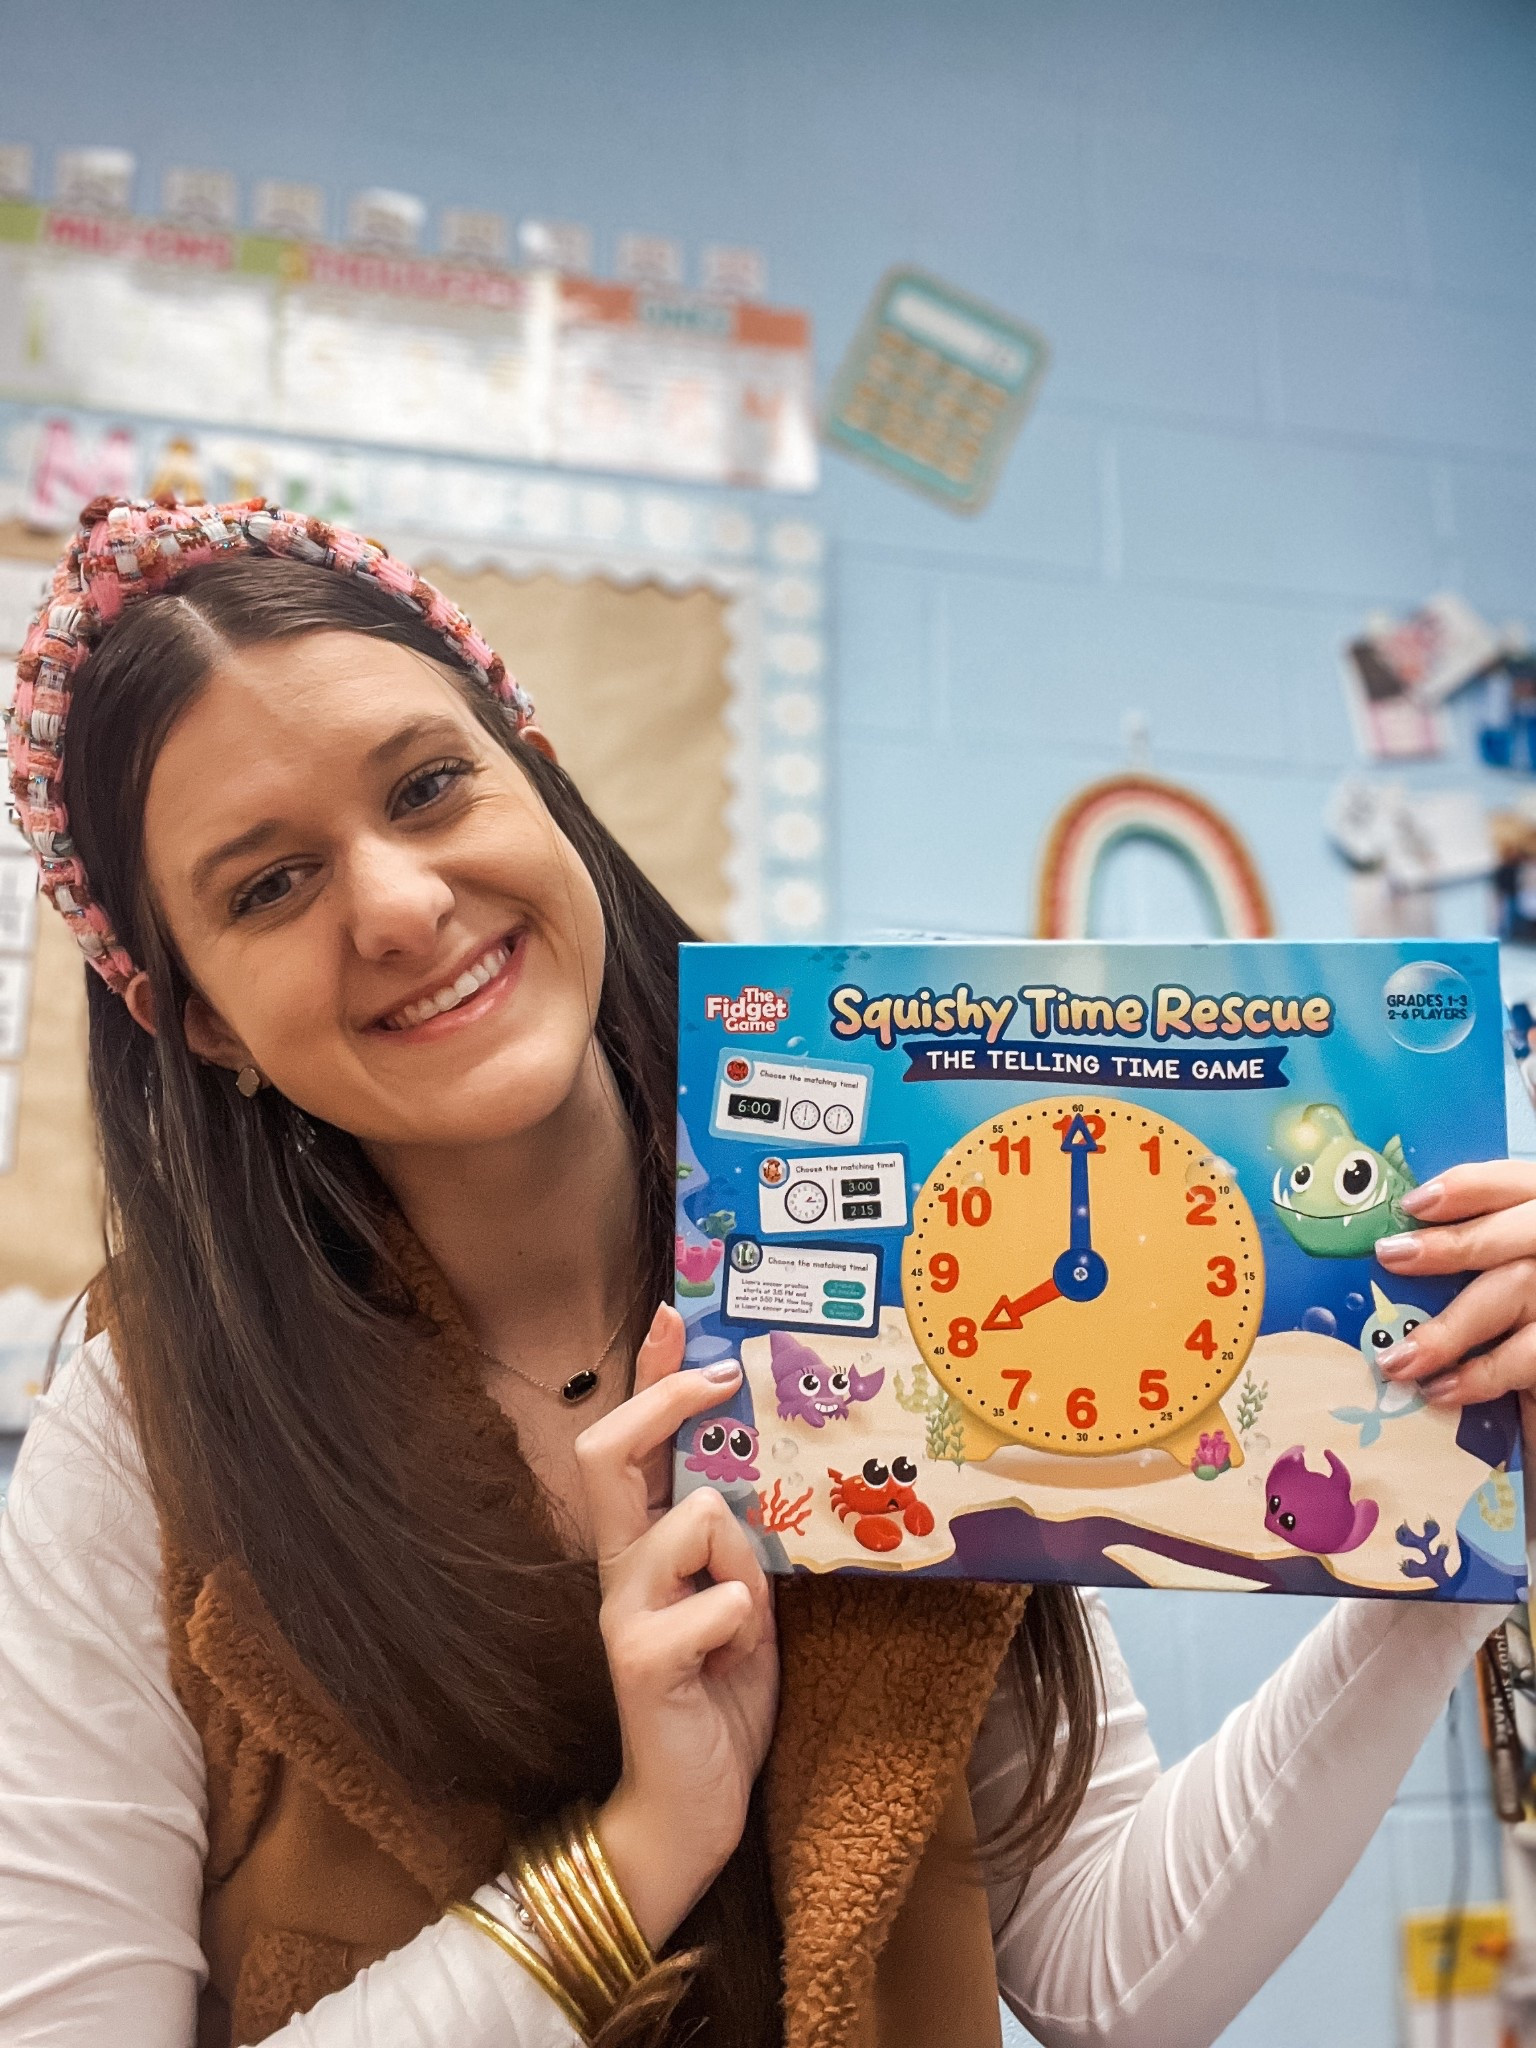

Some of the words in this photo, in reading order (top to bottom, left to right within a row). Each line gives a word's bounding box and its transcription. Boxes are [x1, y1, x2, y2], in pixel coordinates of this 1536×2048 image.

[744, 987, 774, 1003] The
[1386, 993, 1443, 1007] GRADES
[1447, 994, 1468, 1007] 1-3
[706, 996, 788, 1021] Fidget
[832, 985, 1016, 1047] Squishy
[1022, 986, 1145, 1036] Time
[1155, 986, 1333, 1038] Rescue
[1387, 1009, 1409, 1020] 2-6
[1412, 1008, 1467, 1020] PLAYERS
[725, 1017, 776, 1032] Game
[926, 1050, 976, 1070] THE
[987, 1050, 1100, 1074] TELLING
[1111, 1056, 1181, 1079] TIME
[1192, 1058, 1265, 1080] GAME
[760, 1069, 786, 1079] Choose
[789, 1074, 801, 1082] the
[804, 1077, 837, 1088] matching
[737, 1099, 771, 1115] 6:00
[1072, 1104, 1084, 1112] 60
[992, 1124, 1004, 1133] 55
[1158, 1126, 1165, 1134] 5
[989, 1135, 1031, 1176] 11
[1139, 1135, 1161, 1176] 1
[840, 1163, 874, 1171] matching
[933, 1183, 945, 1192] 50
[1218, 1186, 1230, 1194] 10
[937, 1186, 992, 1227] 10
[1185, 1185, 1217, 1226] 2
[798, 1259, 810, 1267] the
[813, 1262, 846, 1271] matching
[911, 1268, 923, 1277] 45
[928, 1252, 960, 1293] 9
[1206, 1255, 1238, 1297] 3
[1244, 1272, 1256, 1281] 15
[947, 1316, 978, 1358] 8
[1184, 1319, 1219, 1360] 4
[933, 1347, 945, 1355] 40
[1221, 1352, 1234, 1361] 20
[1001, 1369, 1032, 1410] 7
[1138, 1369, 1169, 1410] 5
[992, 1408, 1005, 1417] 35
[1066, 1387, 1098, 1429] 6
[1160, 1412, 1173, 1421] 25
[1076, 1432, 1089, 1442] 30
